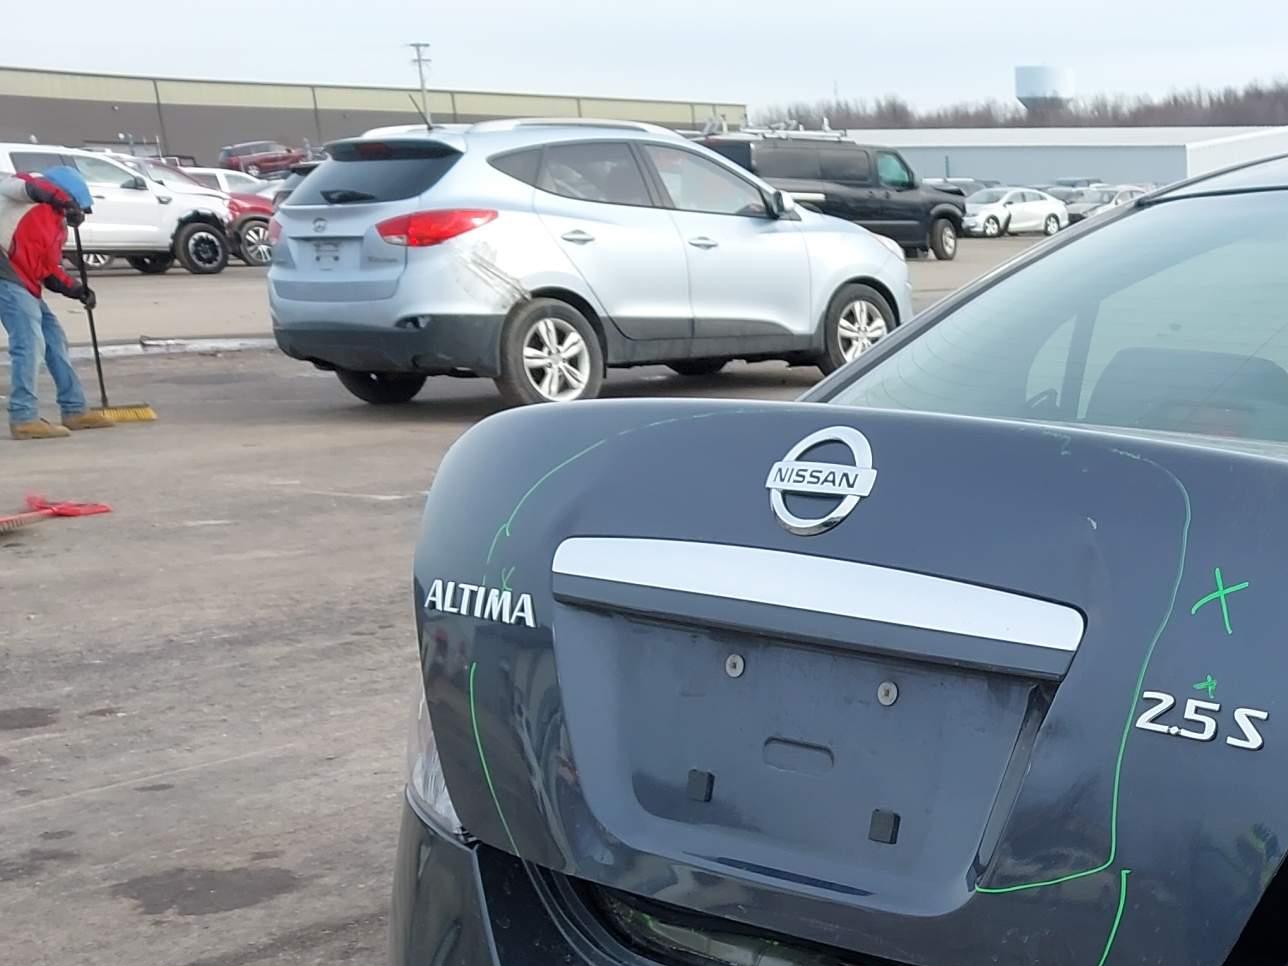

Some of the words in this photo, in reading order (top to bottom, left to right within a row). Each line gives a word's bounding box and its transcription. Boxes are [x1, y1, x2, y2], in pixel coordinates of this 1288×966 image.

[773, 467, 859, 489] NISSAN
[424, 579, 537, 628] ALTIMA
[1136, 691, 1220, 741] 2.5
[1226, 707, 1269, 750] S
